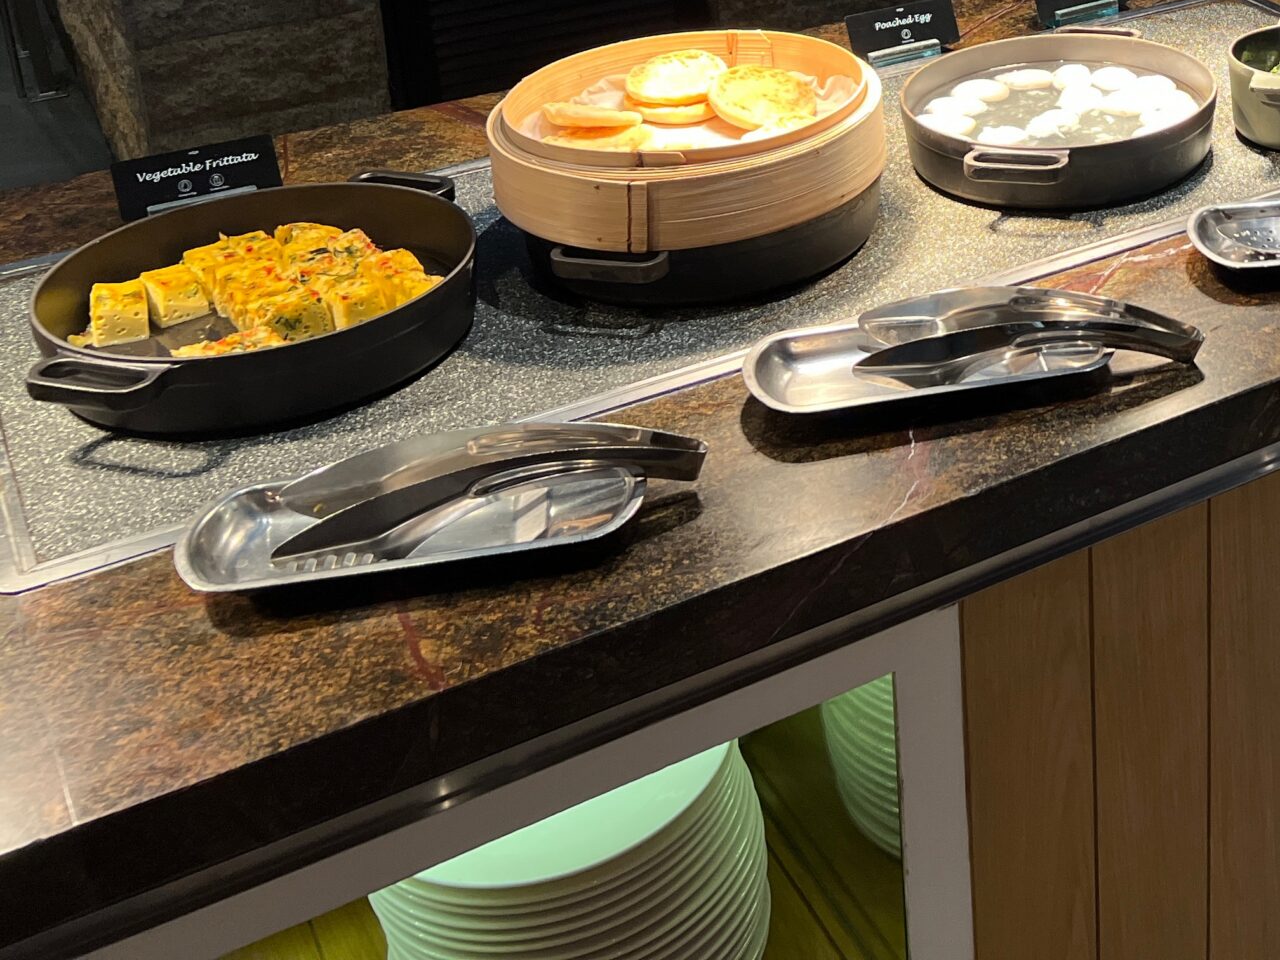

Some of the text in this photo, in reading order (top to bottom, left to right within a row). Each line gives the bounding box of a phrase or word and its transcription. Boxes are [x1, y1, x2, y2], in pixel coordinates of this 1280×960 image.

[874, 13, 933, 31] Poached Egg
[136, 152, 260, 183] Vegetable Frittata
